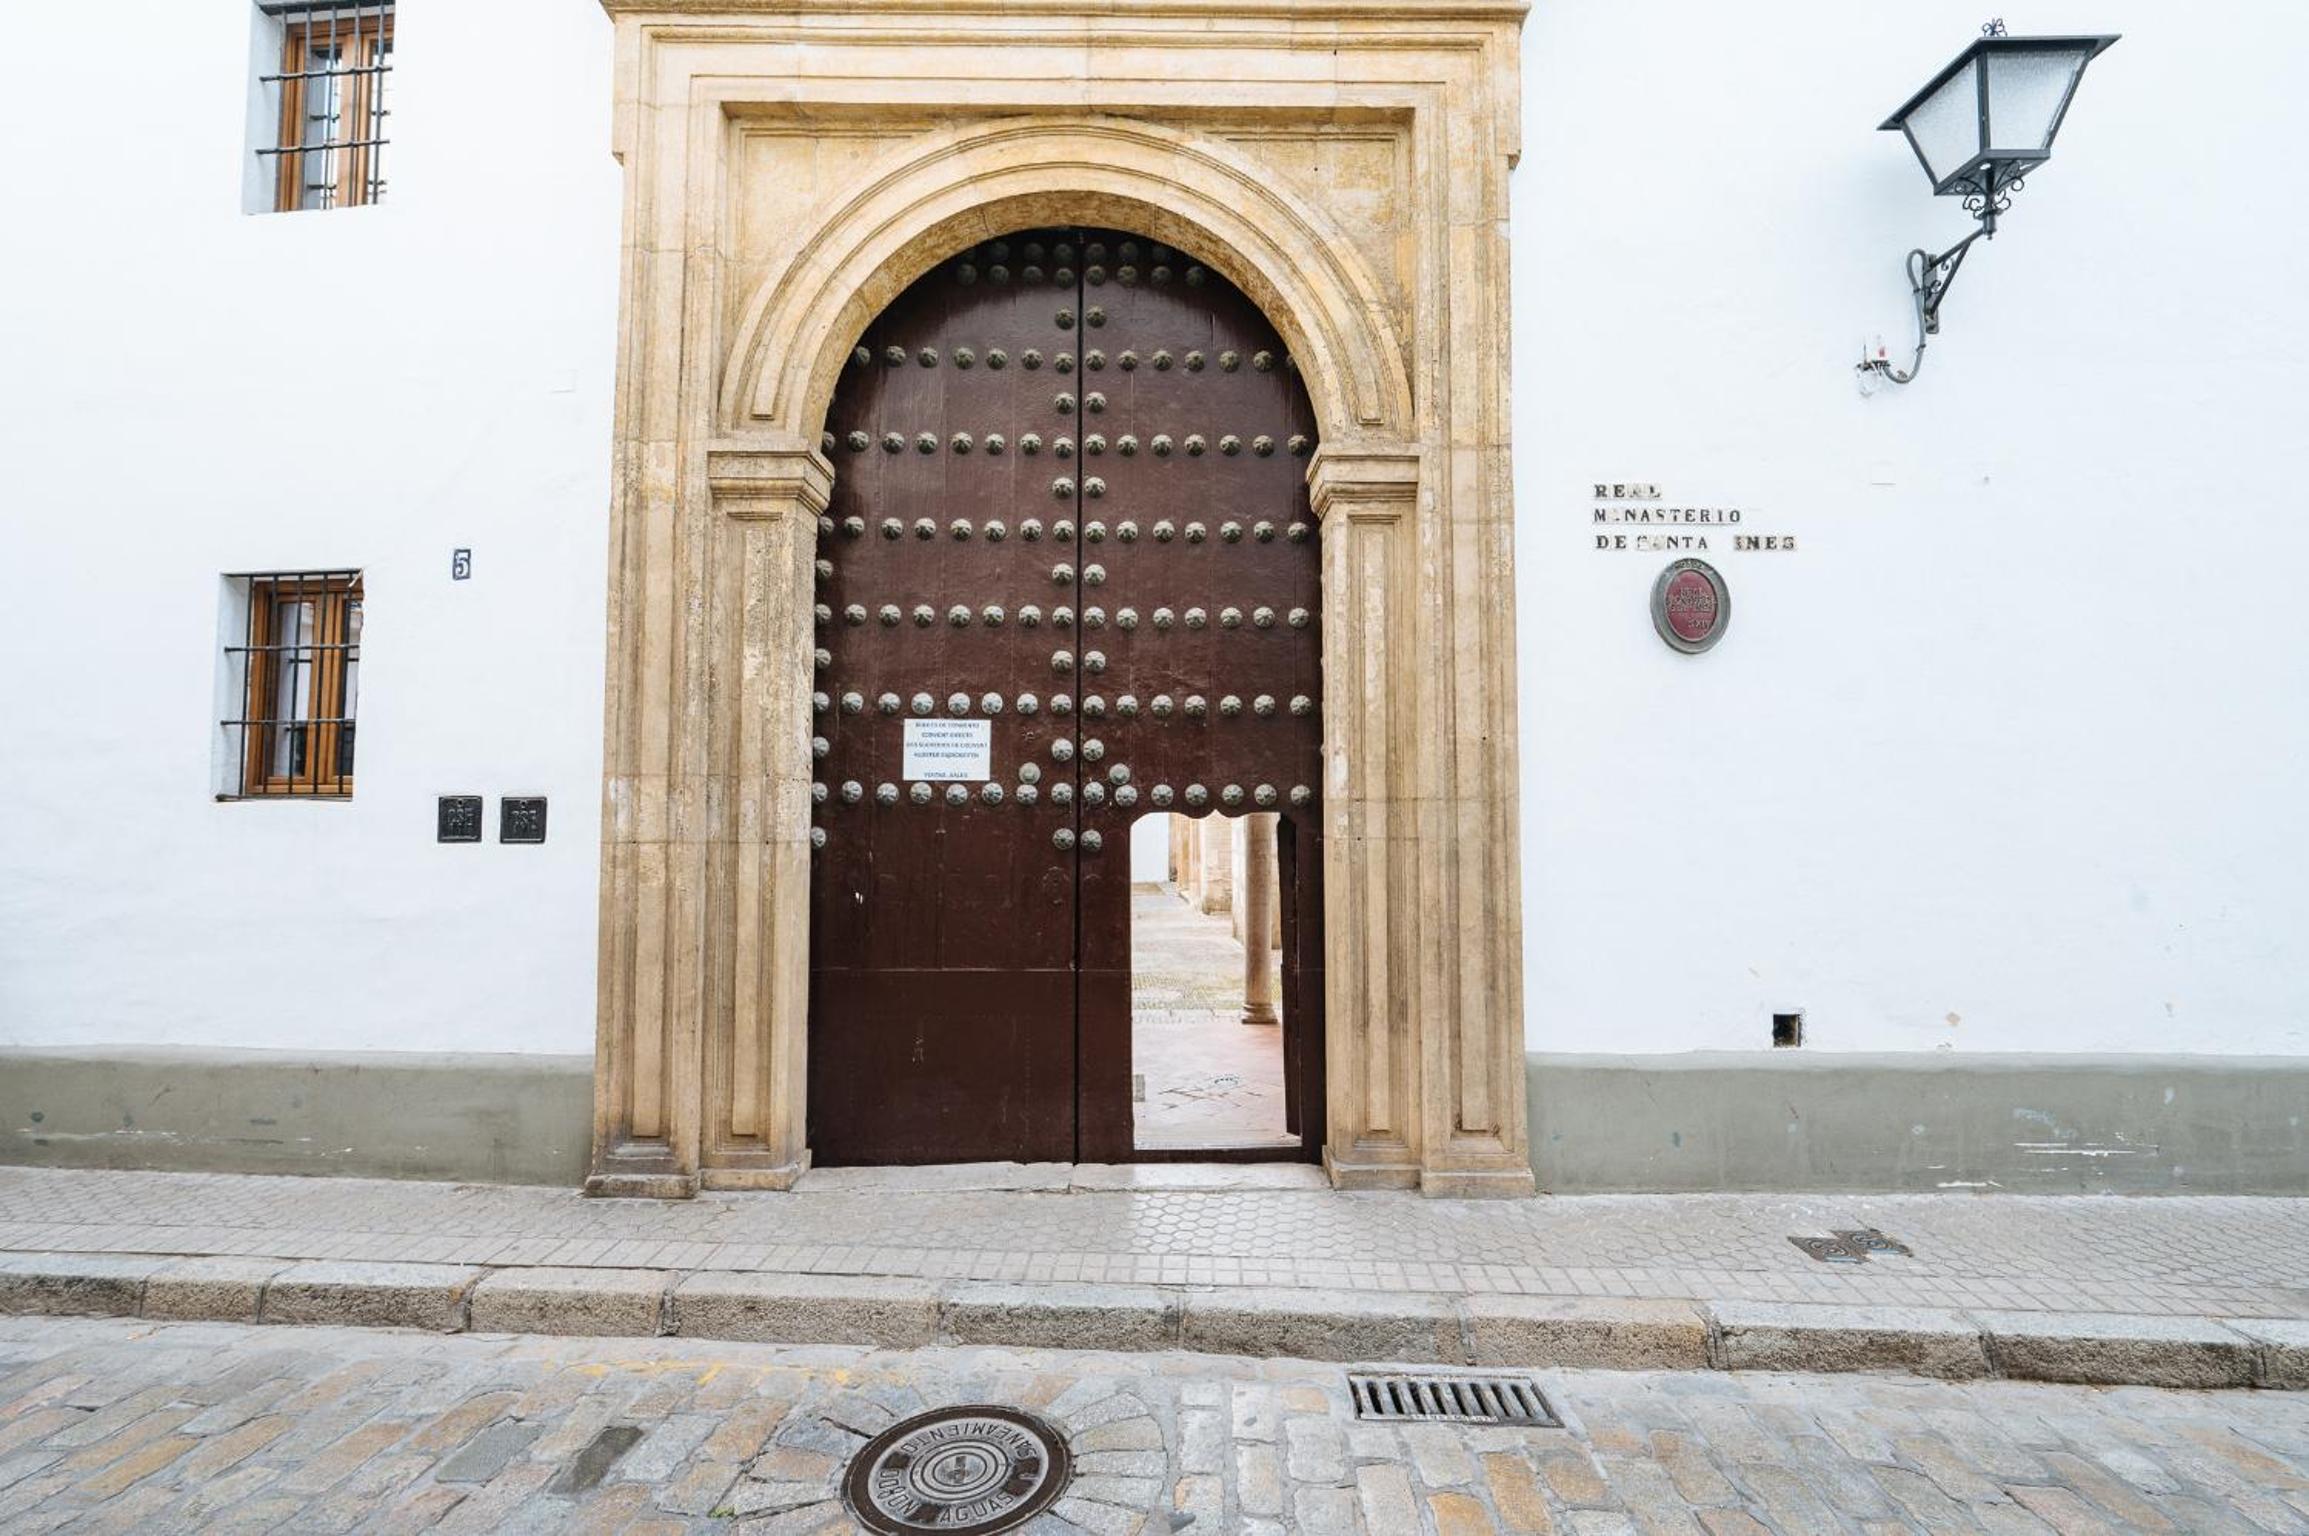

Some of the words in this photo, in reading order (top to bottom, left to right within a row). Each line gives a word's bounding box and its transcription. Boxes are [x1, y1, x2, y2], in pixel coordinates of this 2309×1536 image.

[1594, 508, 1741, 523] MNASTERIO
[1596, 535, 1627, 549] DE
[1637, 535, 1708, 550] NTA
[455, 552, 469, 577] 5
[901, 1421, 1037, 1459] SANEAMIENTO
[939, 1491, 1015, 1523] AGUAS
